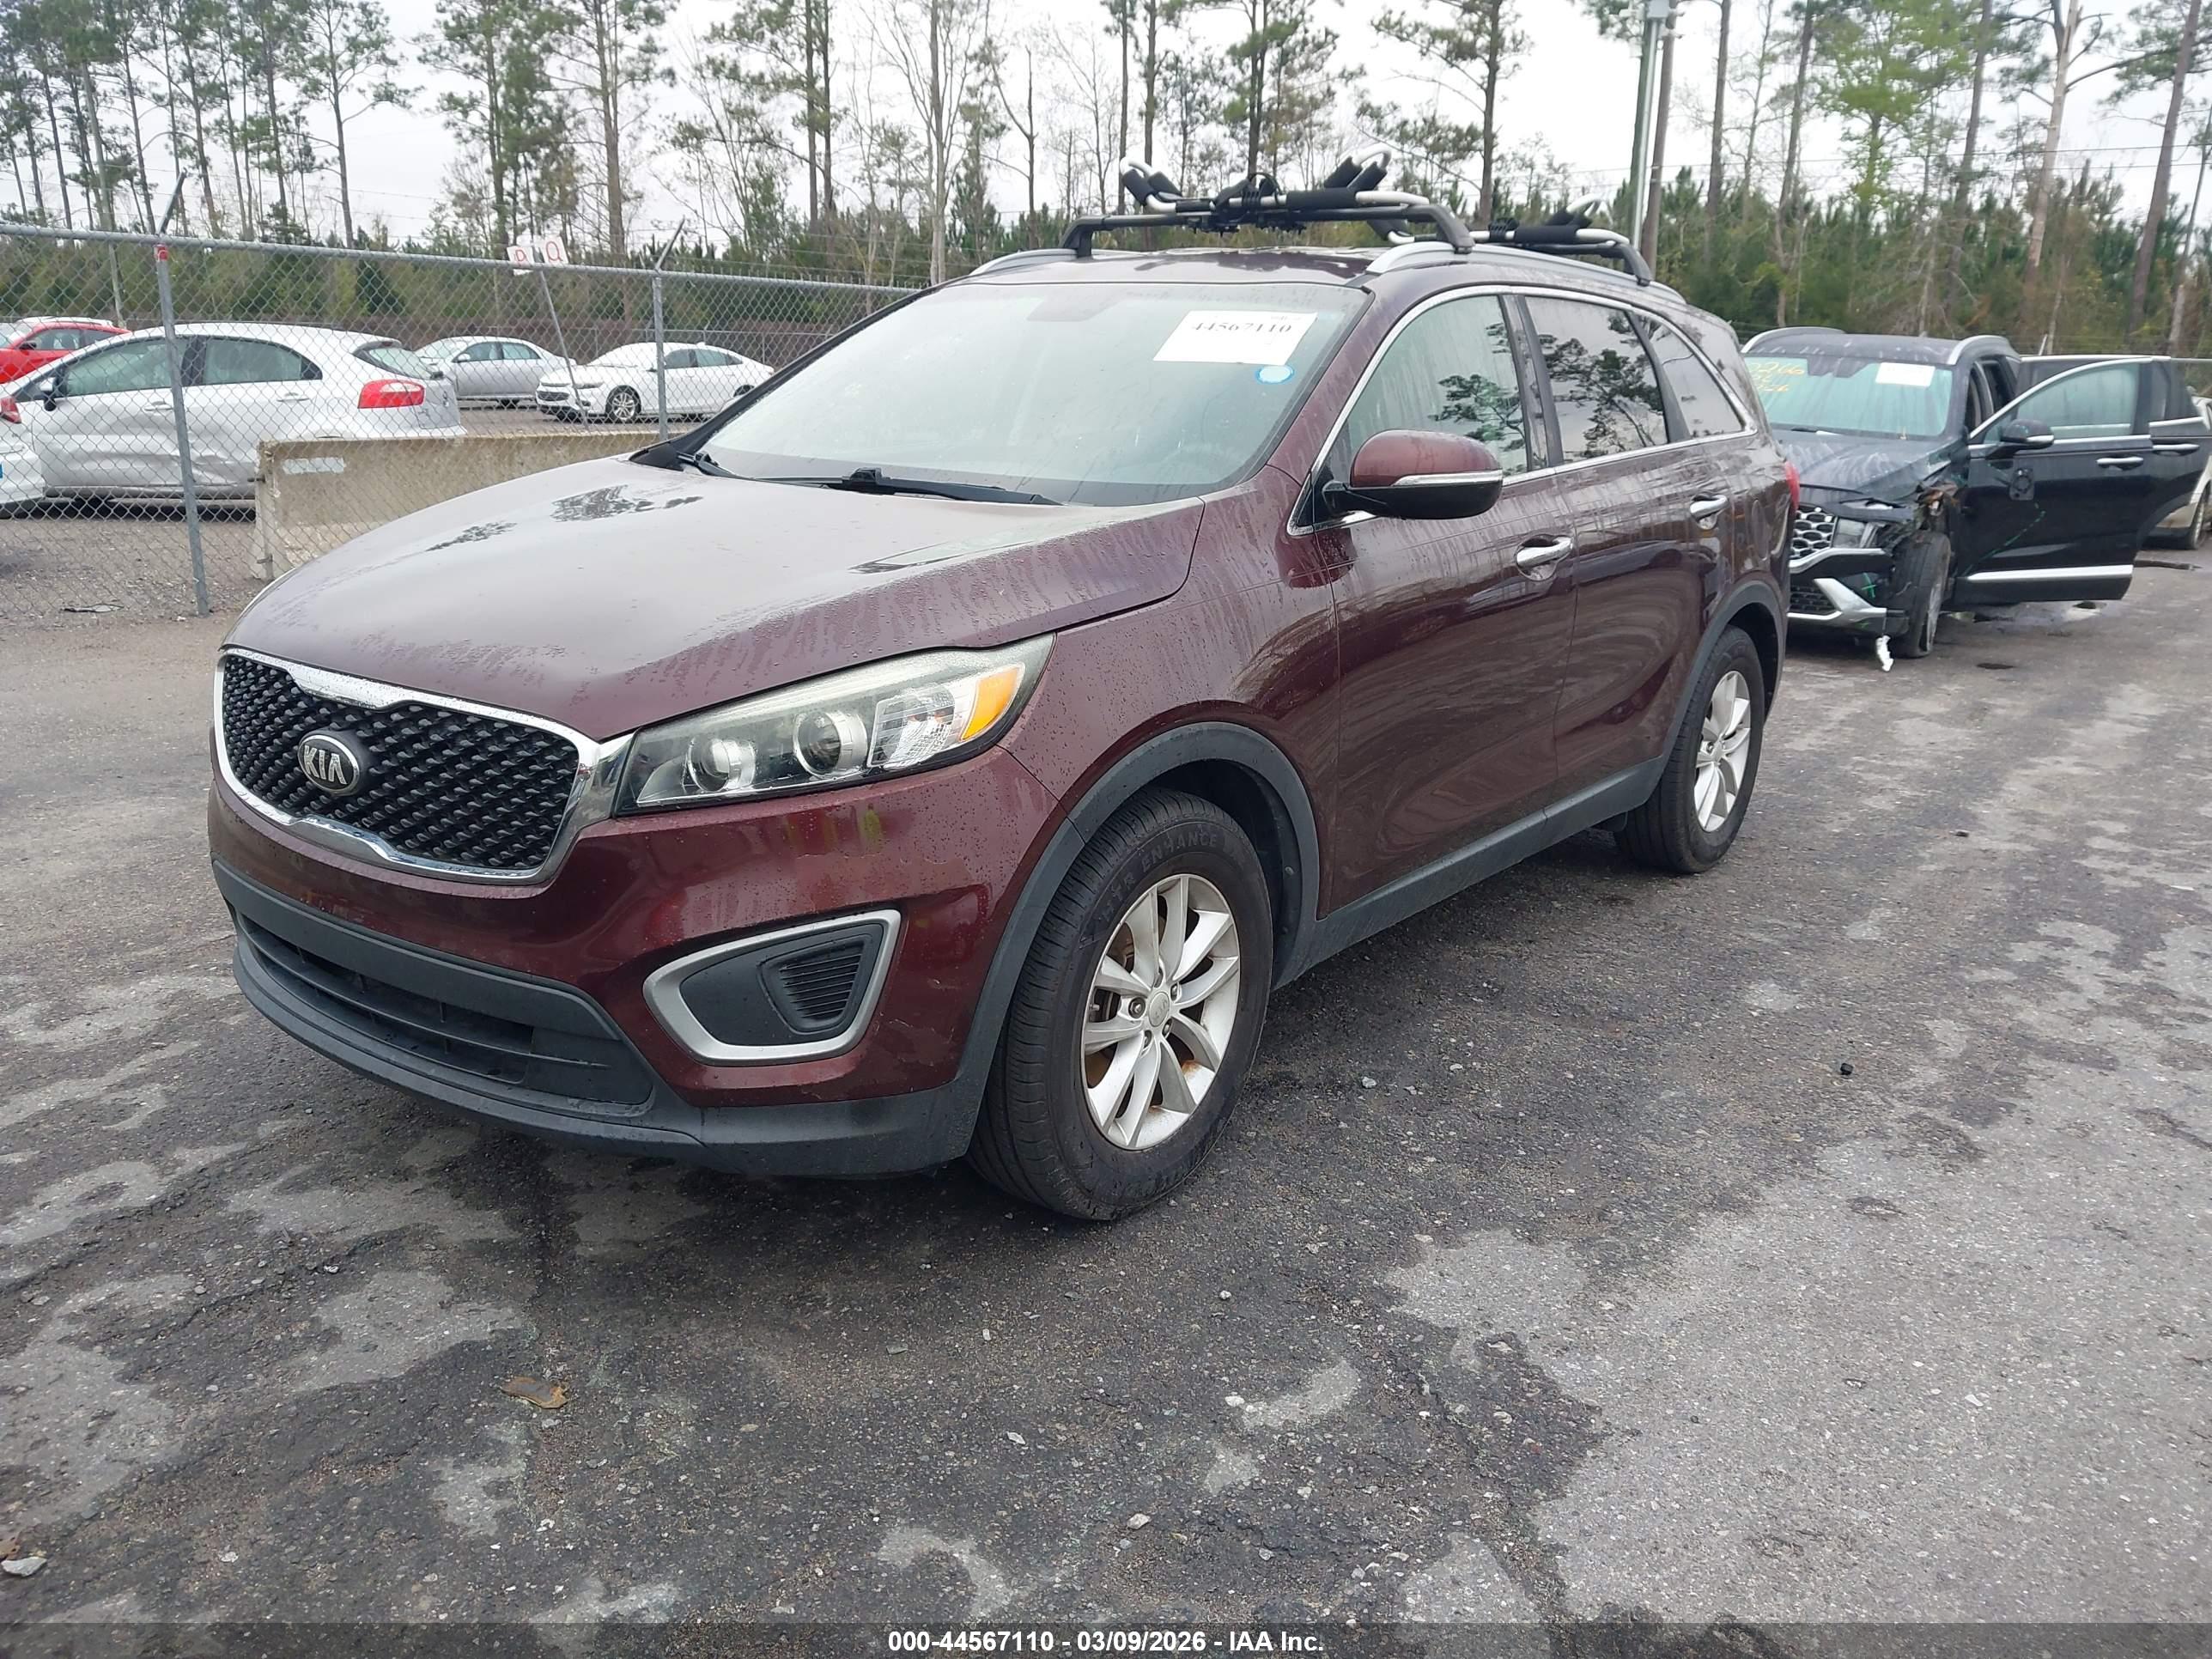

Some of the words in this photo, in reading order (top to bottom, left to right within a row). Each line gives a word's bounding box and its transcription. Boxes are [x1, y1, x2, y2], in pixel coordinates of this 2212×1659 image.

[545, 240, 564, 262] Q
[303, 744, 348, 784] KIA
[1141, 830, 1217, 873] ENHANCE
